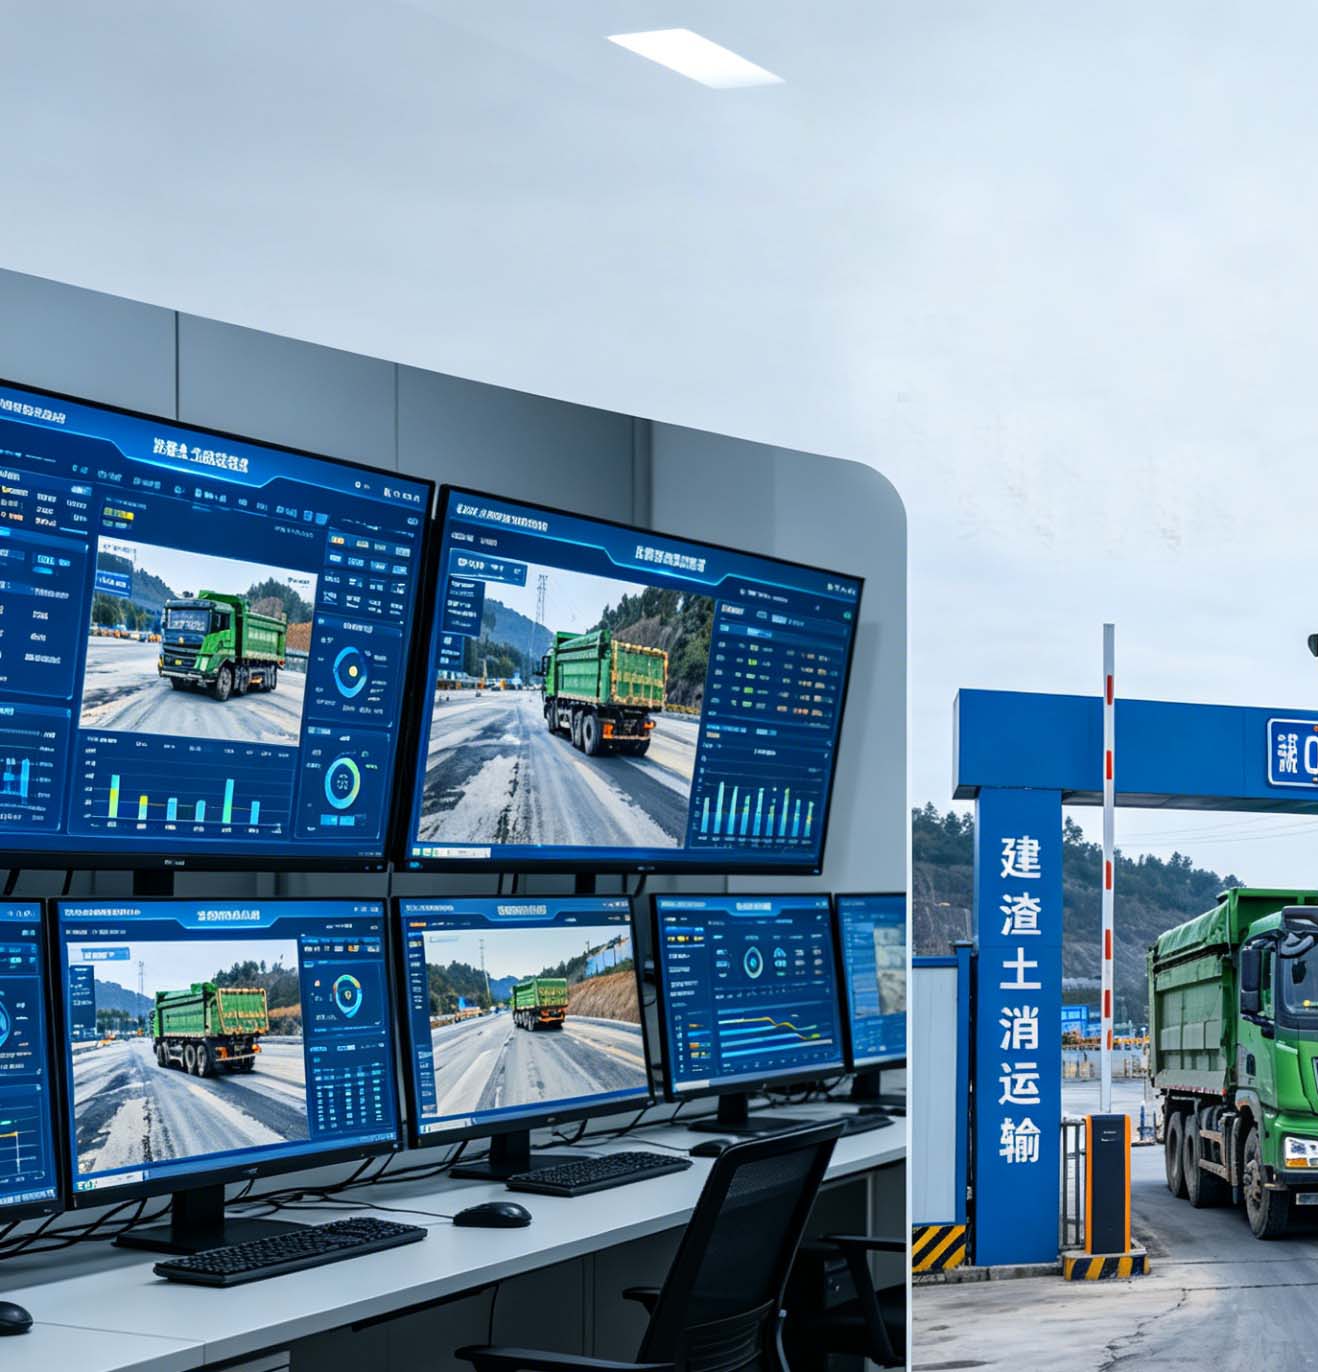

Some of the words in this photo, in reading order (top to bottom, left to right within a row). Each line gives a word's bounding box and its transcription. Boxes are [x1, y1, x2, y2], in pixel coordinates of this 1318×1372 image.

[998, 835, 1042, 1164] 建渣土消运输
